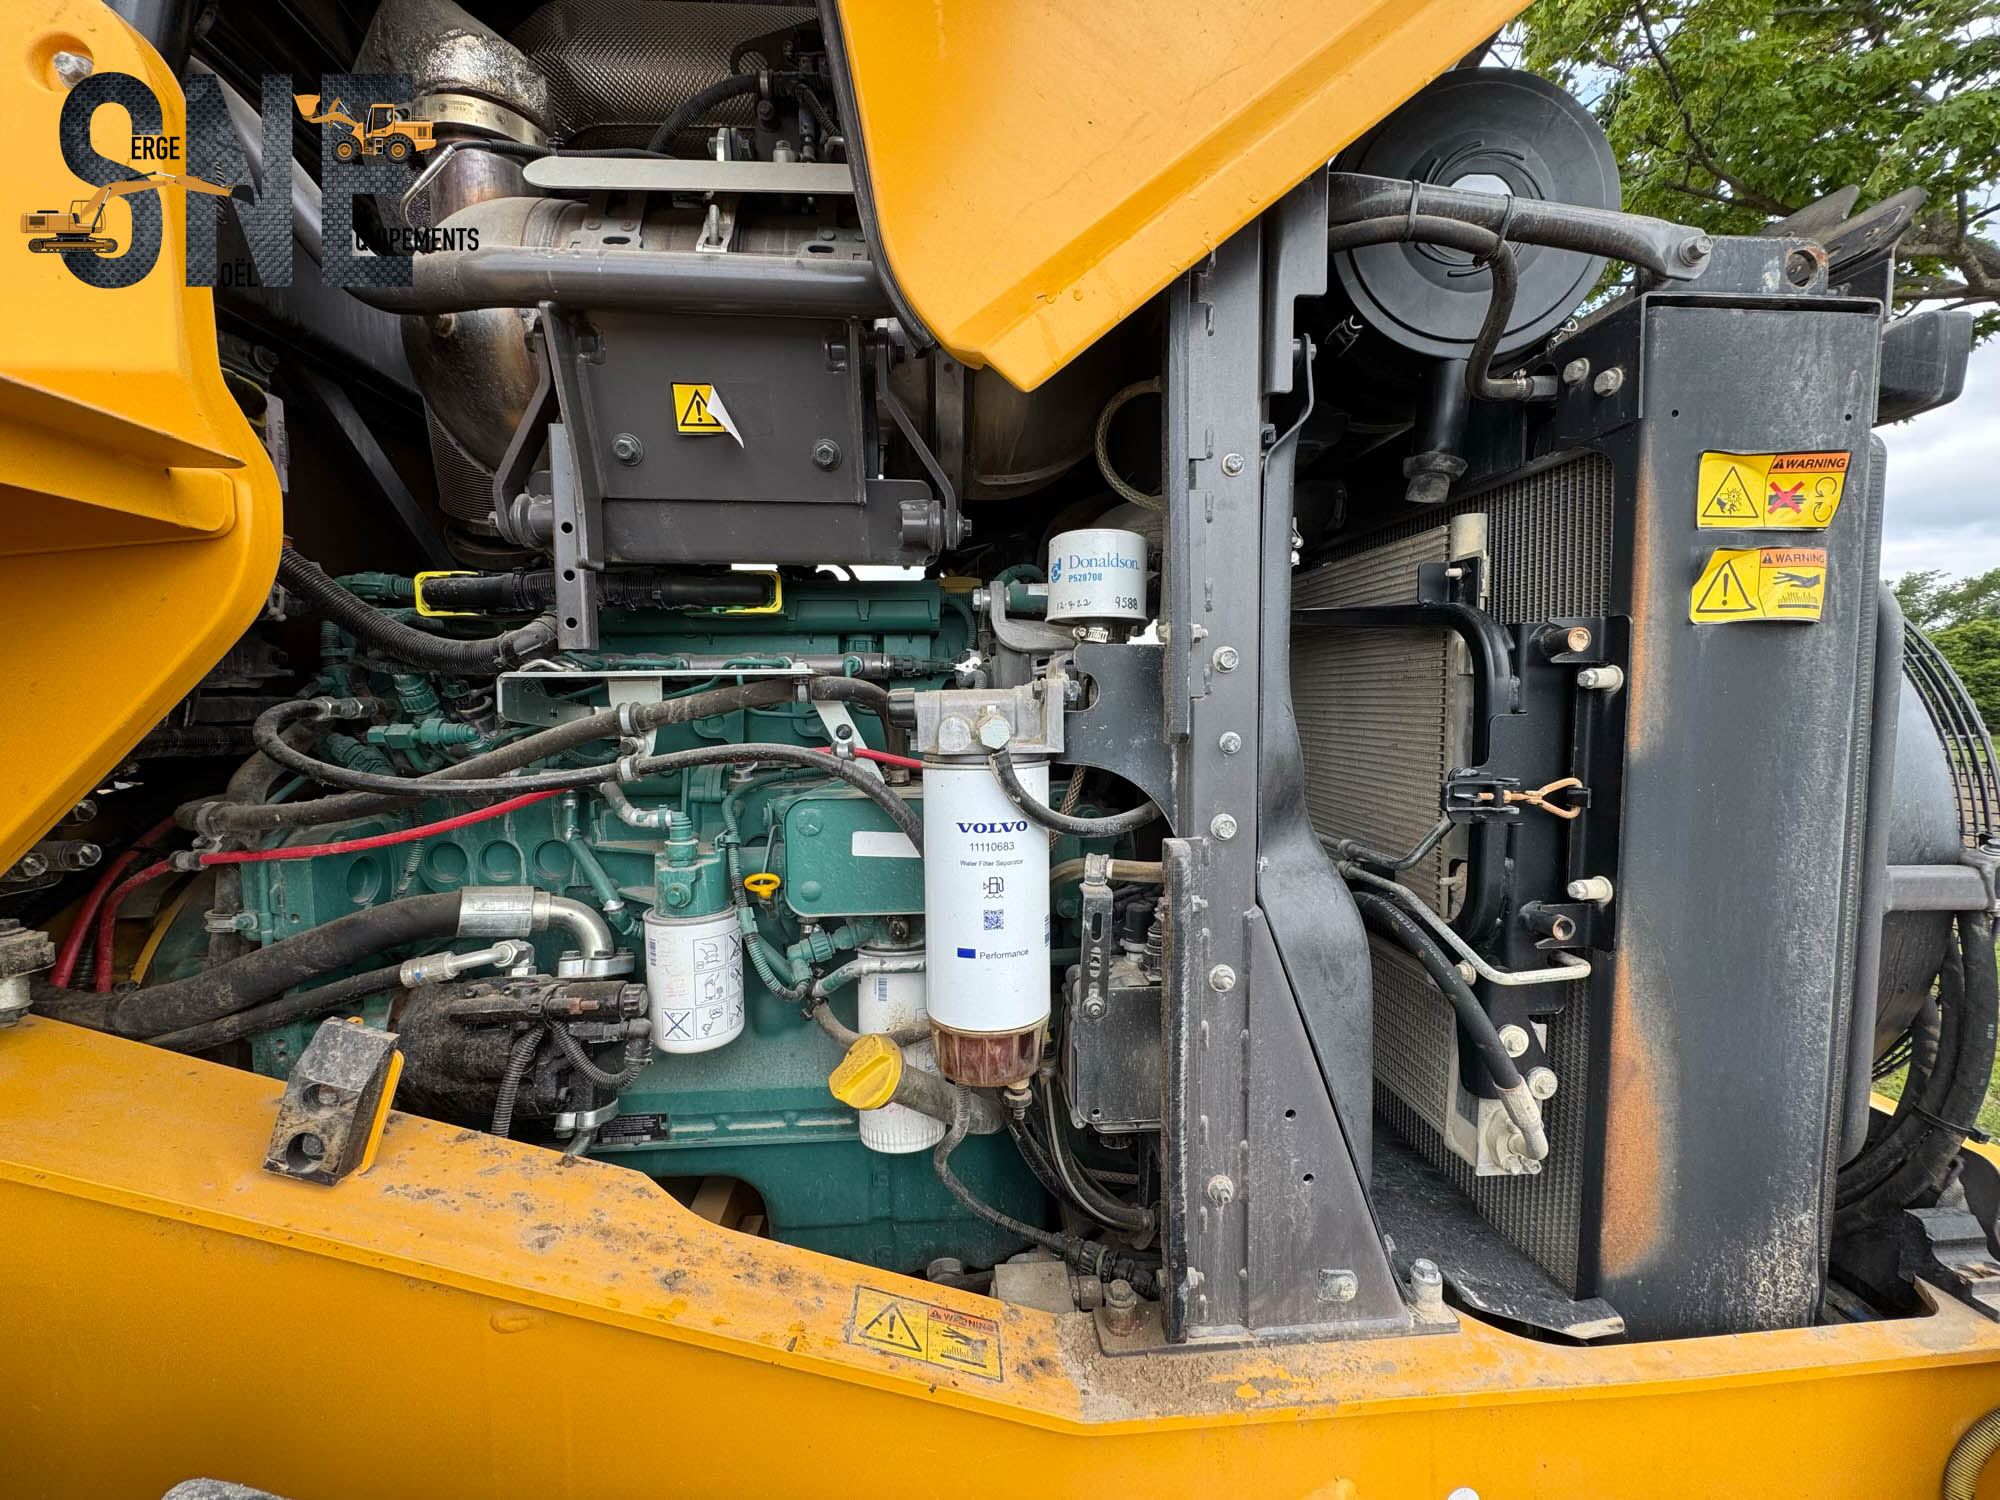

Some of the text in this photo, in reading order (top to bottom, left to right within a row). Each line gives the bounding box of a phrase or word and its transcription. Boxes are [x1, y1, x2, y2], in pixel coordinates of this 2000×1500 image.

[1786, 458, 1847, 469] WARNING
[1068, 552, 1139, 570] Donaldson
[1775, 553, 1825, 563] WARNING
[1115, 596, 1138, 610] 9588
[955, 820, 1028, 833] VOLVO
[969, 841, 1015, 852] 11110683
[979, 948, 1029, 960] Performance
[943, 1312, 994, 1332] WNIN
